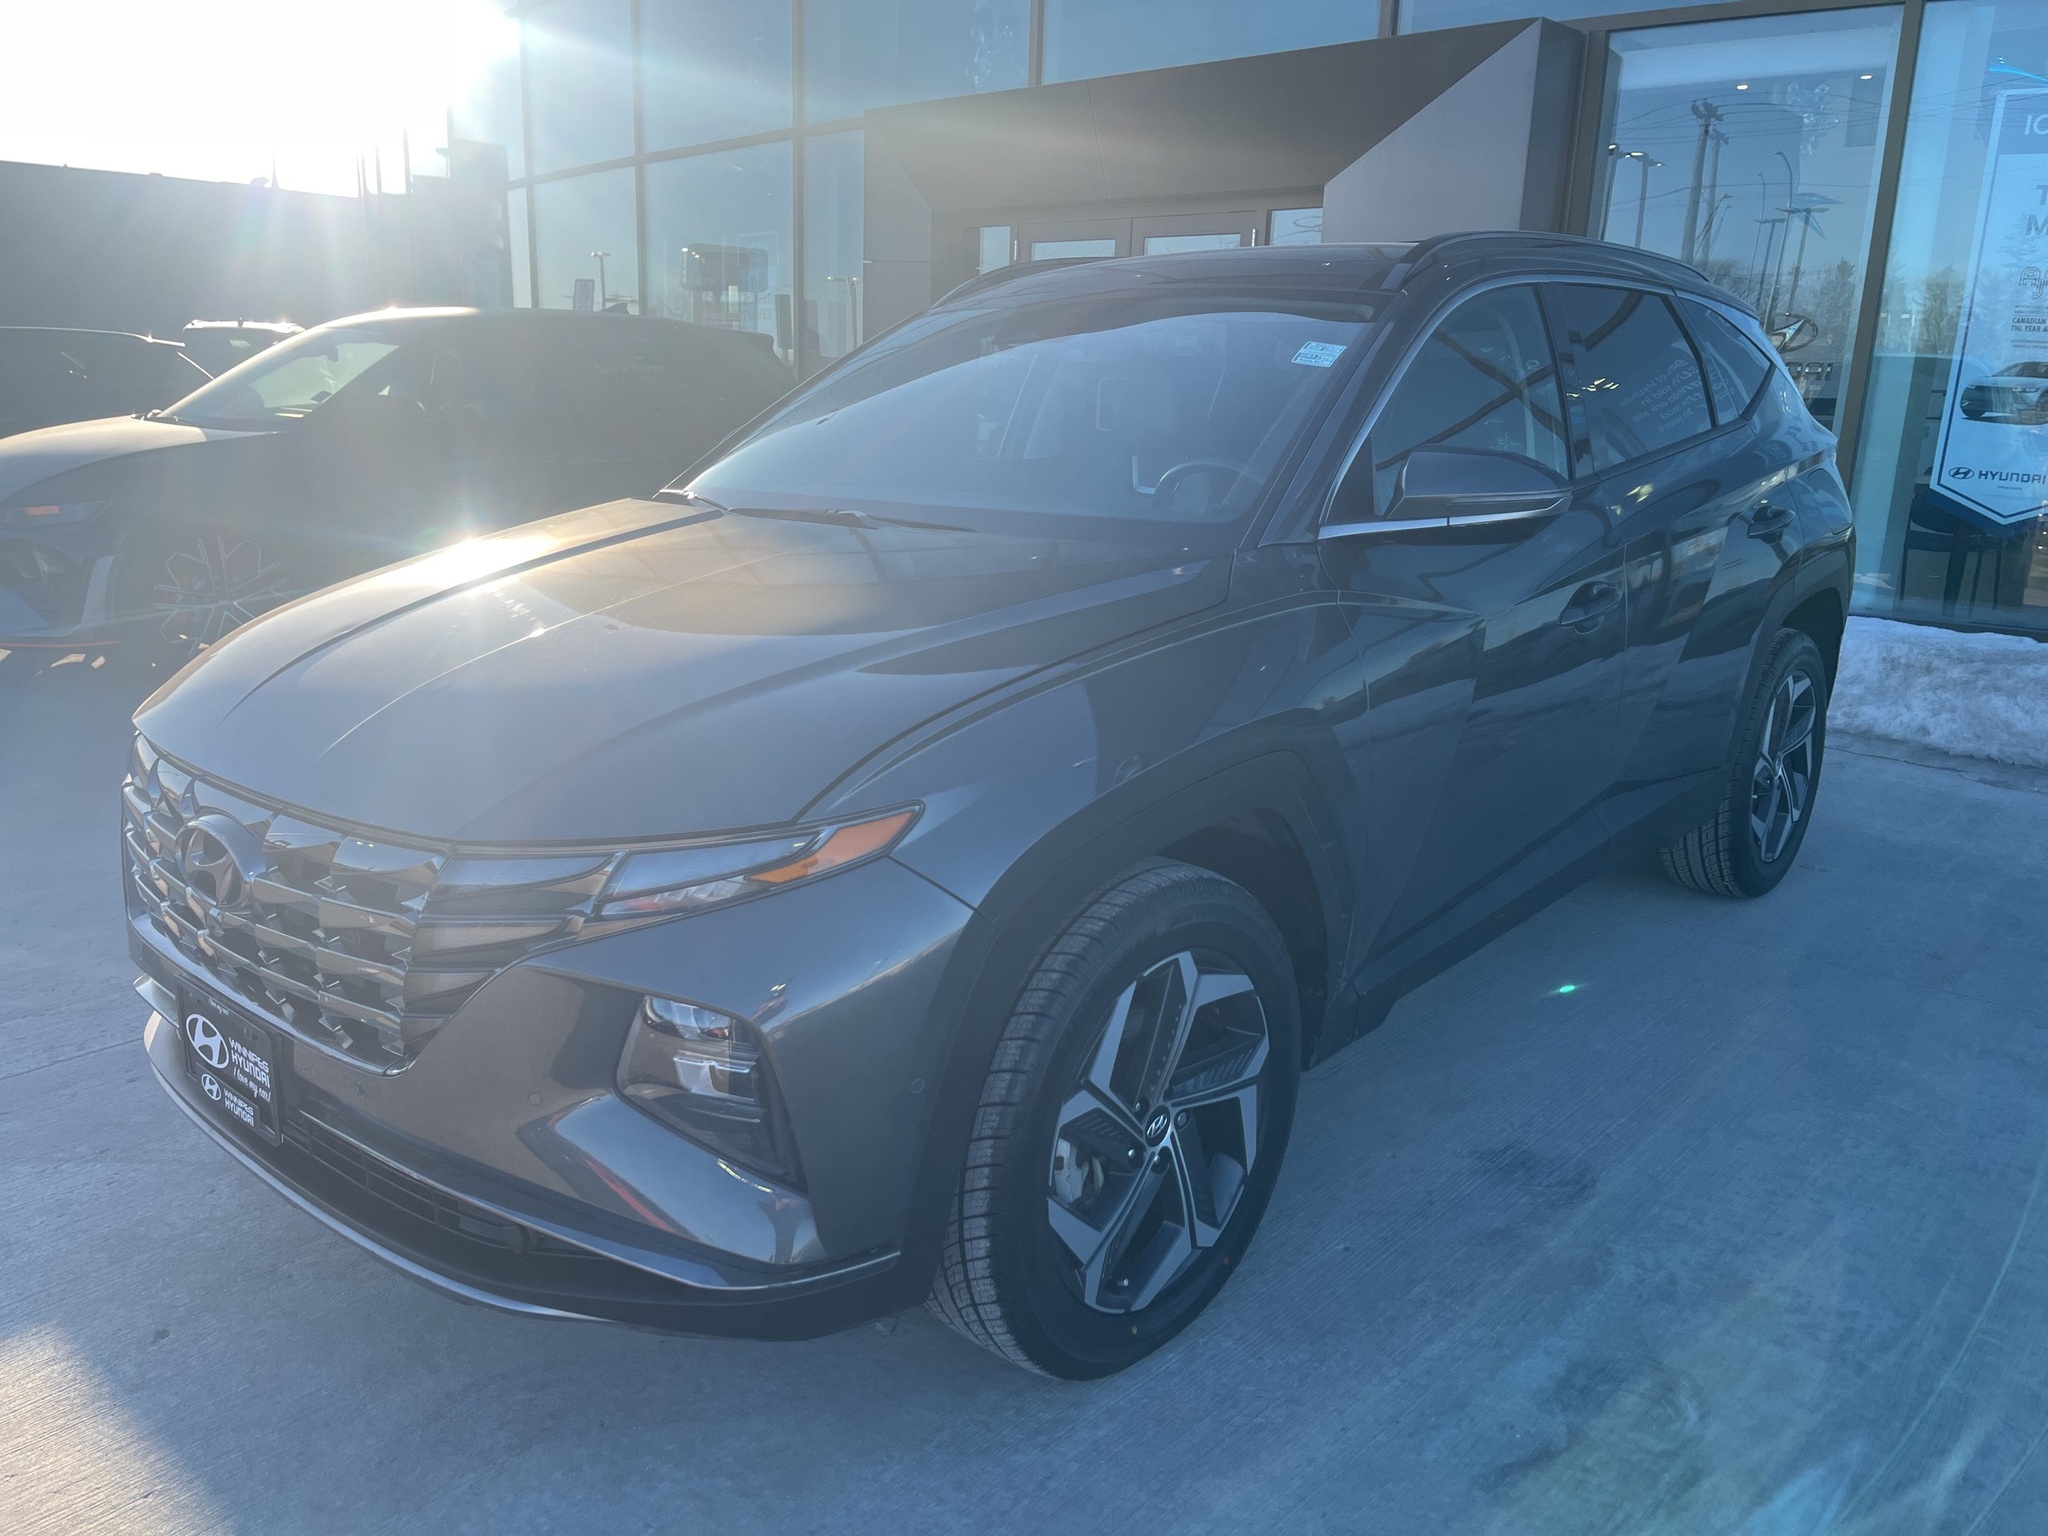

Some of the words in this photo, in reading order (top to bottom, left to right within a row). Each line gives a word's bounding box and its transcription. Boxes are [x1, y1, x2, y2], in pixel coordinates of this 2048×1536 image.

[2012, 317, 2046, 325] CANADIAN
[2025, 325, 2040, 333] YEAR
[1978, 470, 2046, 485] HYUNDAI
[228, 1037, 269, 1073] WINNIPEG
[231, 1050, 270, 1088] HYUNDAI
[225, 1097, 254, 1127] HYUNDAI
